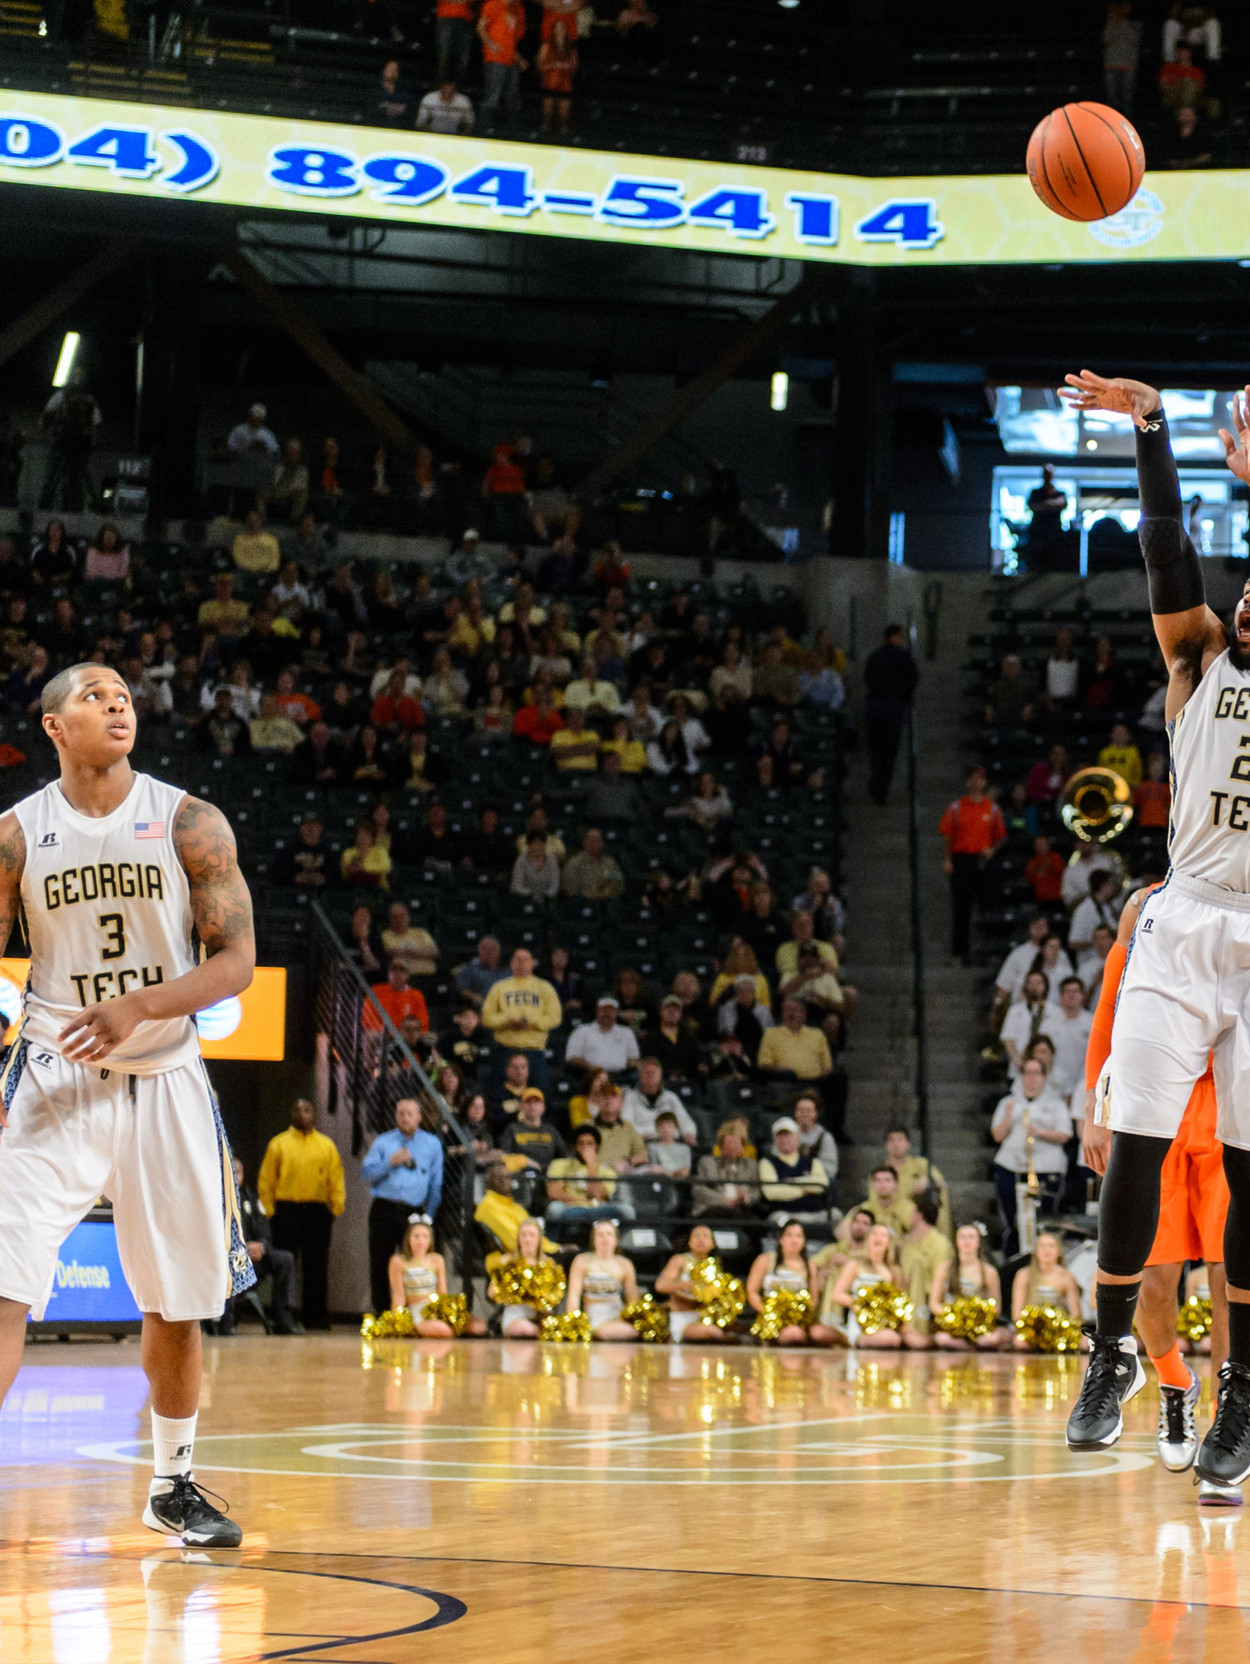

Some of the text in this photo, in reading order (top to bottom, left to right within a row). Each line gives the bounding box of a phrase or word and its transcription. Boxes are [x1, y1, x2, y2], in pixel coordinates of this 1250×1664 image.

[0, 113, 220, 193] 04)
[266, 142, 946, 250] 894-5414
[43, 862, 164, 911] GEORGIA
[99, 912, 128, 962] 3
[56, 1259, 111, 1289] Defense
